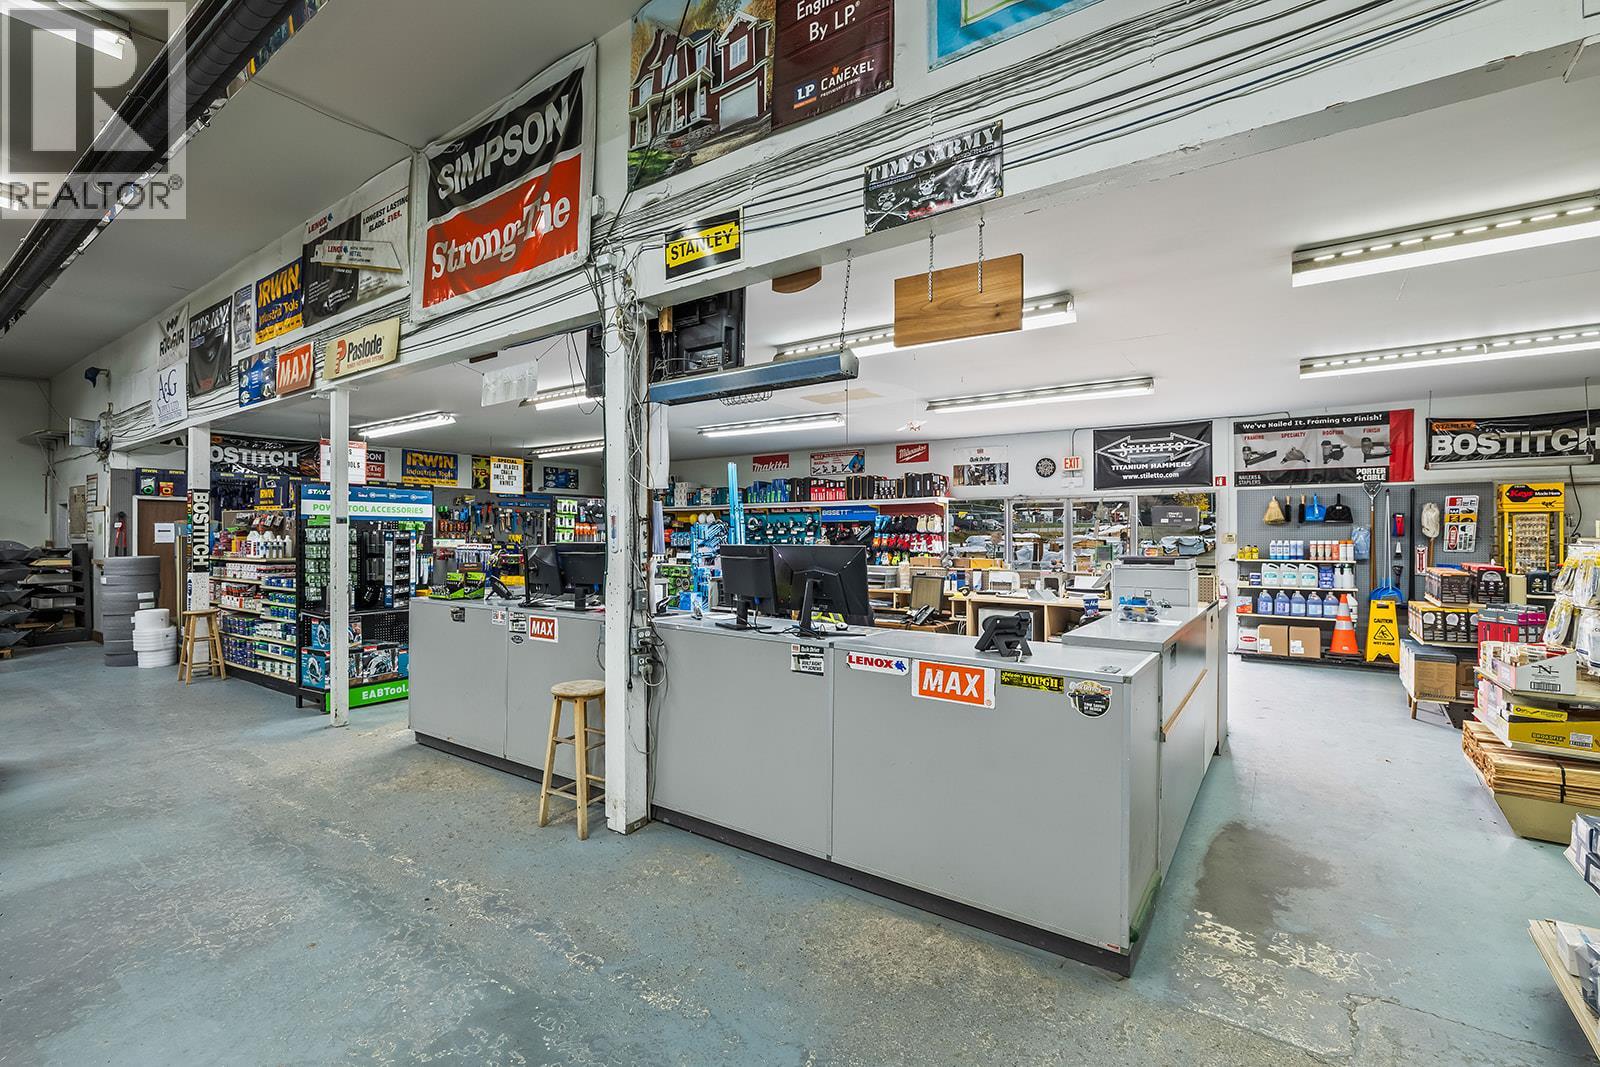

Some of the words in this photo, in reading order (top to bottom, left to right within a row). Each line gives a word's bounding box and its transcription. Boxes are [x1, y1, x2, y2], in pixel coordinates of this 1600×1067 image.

[797, 0, 837, 21] Engin
[809, 22, 828, 41] By
[797, 83, 816, 100] LP
[437, 94, 569, 200] SIMPSON
[932, 126, 998, 162] ARMY
[307, 216, 328, 234] LENOX
[363, 207, 388, 226] LONGEST
[431, 191, 571, 280] Strong-Tie
[670, 227, 734, 261] STANLEY
[257, 263, 302, 308] IRWIN
[347, 333, 383, 363] Paslode
[278, 352, 310, 388] MAX
[1242, 422, 1267, 430] We've
[1267, 420, 1293, 428] Nailed
[1307, 417, 1340, 427] Framing
[1354, 413, 1383, 422] Finish!
[1280, 431, 1307, 439] SPECIALTY
[1431, 427, 1600, 456] BOSTITCH
[210, 444, 298, 468] OSTITCH
[1119, 441, 1184, 458] STILETTO
[406, 452, 455, 470] IRWIN
[1063, 457, 1080, 469] EXIT
[1111, 462, 1149, 471] TITANIUM
[1150, 460, 1192, 469] HAMMERS
[406, 468, 437, 479] Industrial
[1122, 471, 1180, 480] www.stiletto.com
[1356, 467, 1386, 475] PORTER
[307, 488, 325, 496] STAY
[1509, 488, 1534, 499] Keys
[313, 503, 330, 512] POW
[349, 505, 369, 513] TOOL
[371, 505, 424, 514] ACCESSORIES
[193, 492, 210, 566] BOSTITCH
[531, 620, 554, 636] MAX
[847, 654, 894, 669] LENOX
[922, 668, 981, 698] MAX
[1022, 675, 1059, 689] TOUGH
